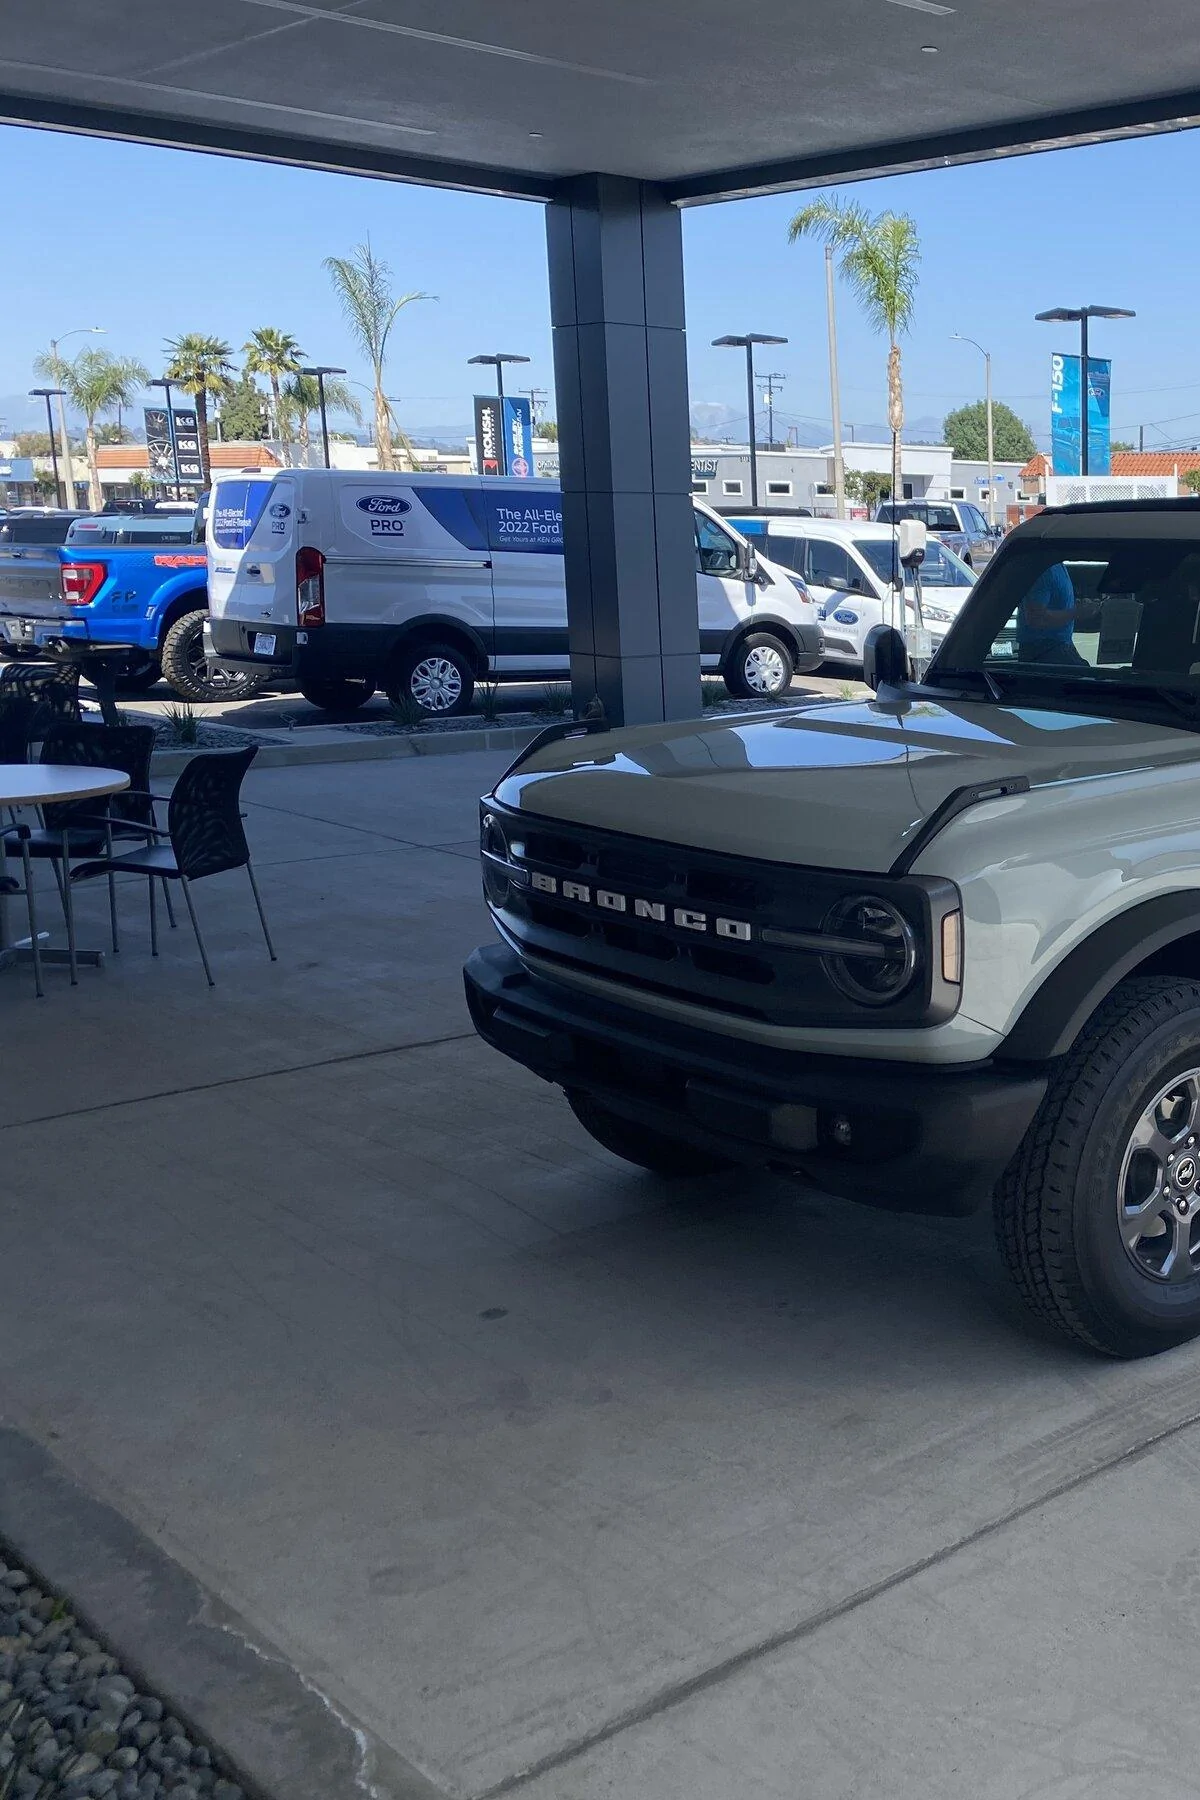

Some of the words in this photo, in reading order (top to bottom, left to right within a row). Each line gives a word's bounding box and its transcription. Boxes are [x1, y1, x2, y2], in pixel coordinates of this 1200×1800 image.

[1051, 355, 1064, 414] F-150
[481, 408, 493, 458] ROUSH
[370, 520, 403, 531] PRO
[496, 508, 521, 520] The
[498, 521, 530, 533] 2022
[532, 522, 560, 534] Ford
[531, 871, 751, 941] BRONCO
